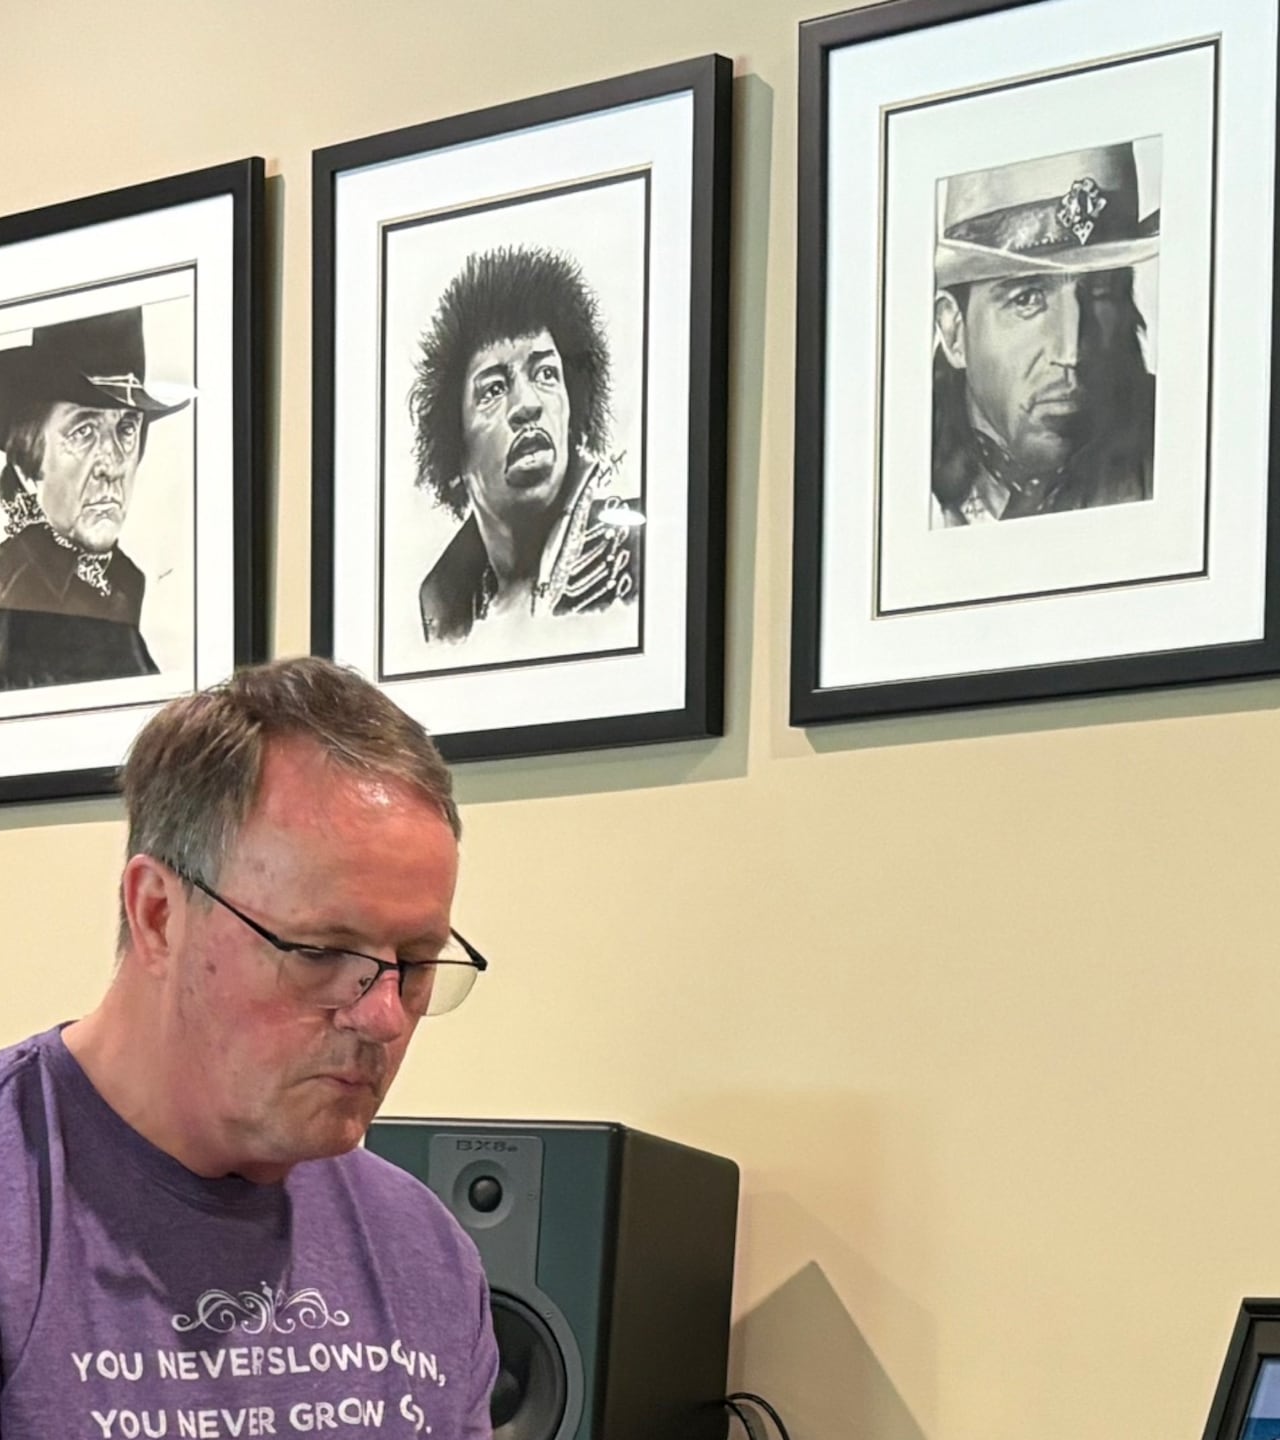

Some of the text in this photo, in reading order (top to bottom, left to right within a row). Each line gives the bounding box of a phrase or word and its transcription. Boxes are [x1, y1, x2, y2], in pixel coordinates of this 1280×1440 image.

[71, 1350, 144, 1382] YOU
[90, 1409, 167, 1440] YOU
[176, 1406, 277, 1439] NEVER
[288, 1397, 385, 1432] GROW
